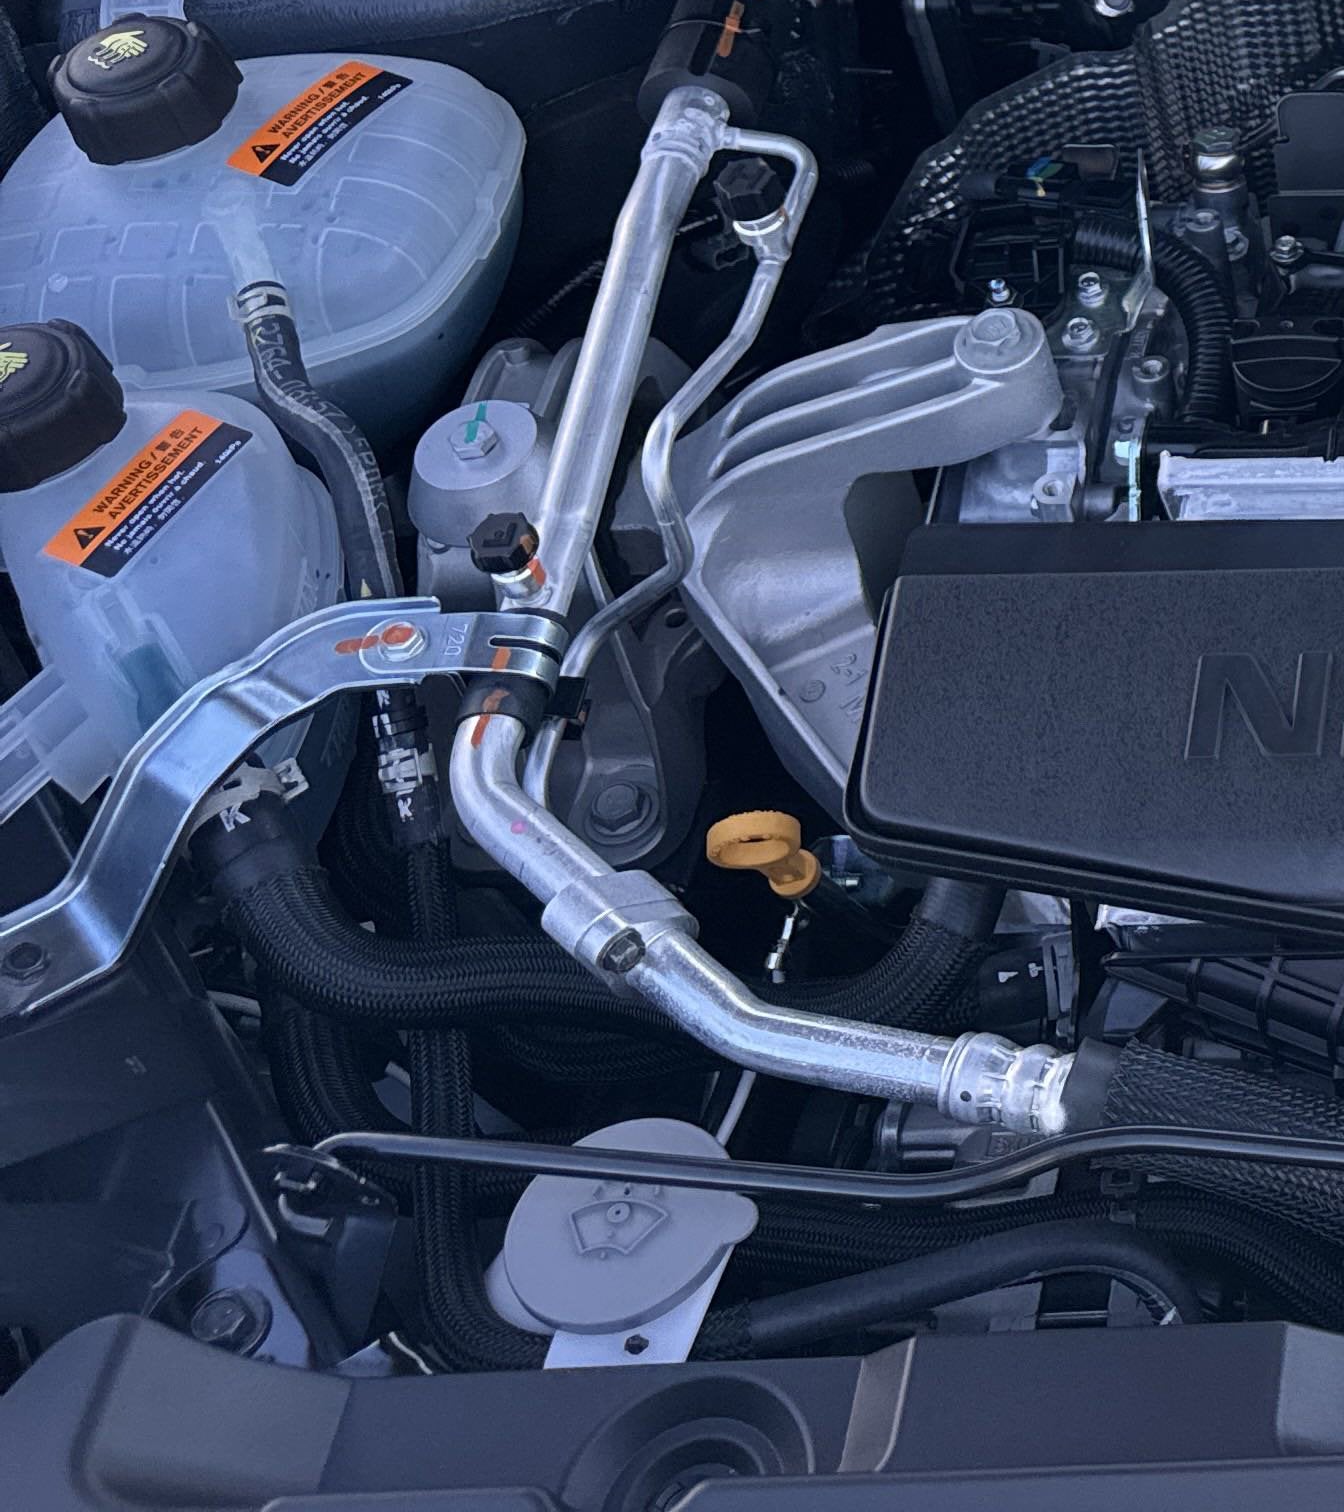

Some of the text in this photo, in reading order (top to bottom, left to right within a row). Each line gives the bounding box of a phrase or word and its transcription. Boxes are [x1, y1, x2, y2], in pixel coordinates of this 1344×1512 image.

[267, 92, 320, 135] WARNING
[280, 71, 367, 139] AVERTISSEMENT
[93, 459, 153, 514] WARNING
[108, 426, 203, 520] AVERTISSEMENT
[104, 524, 129, 547] Never
[148, 483, 169, 505] when
[219, 802, 251, 833] K
